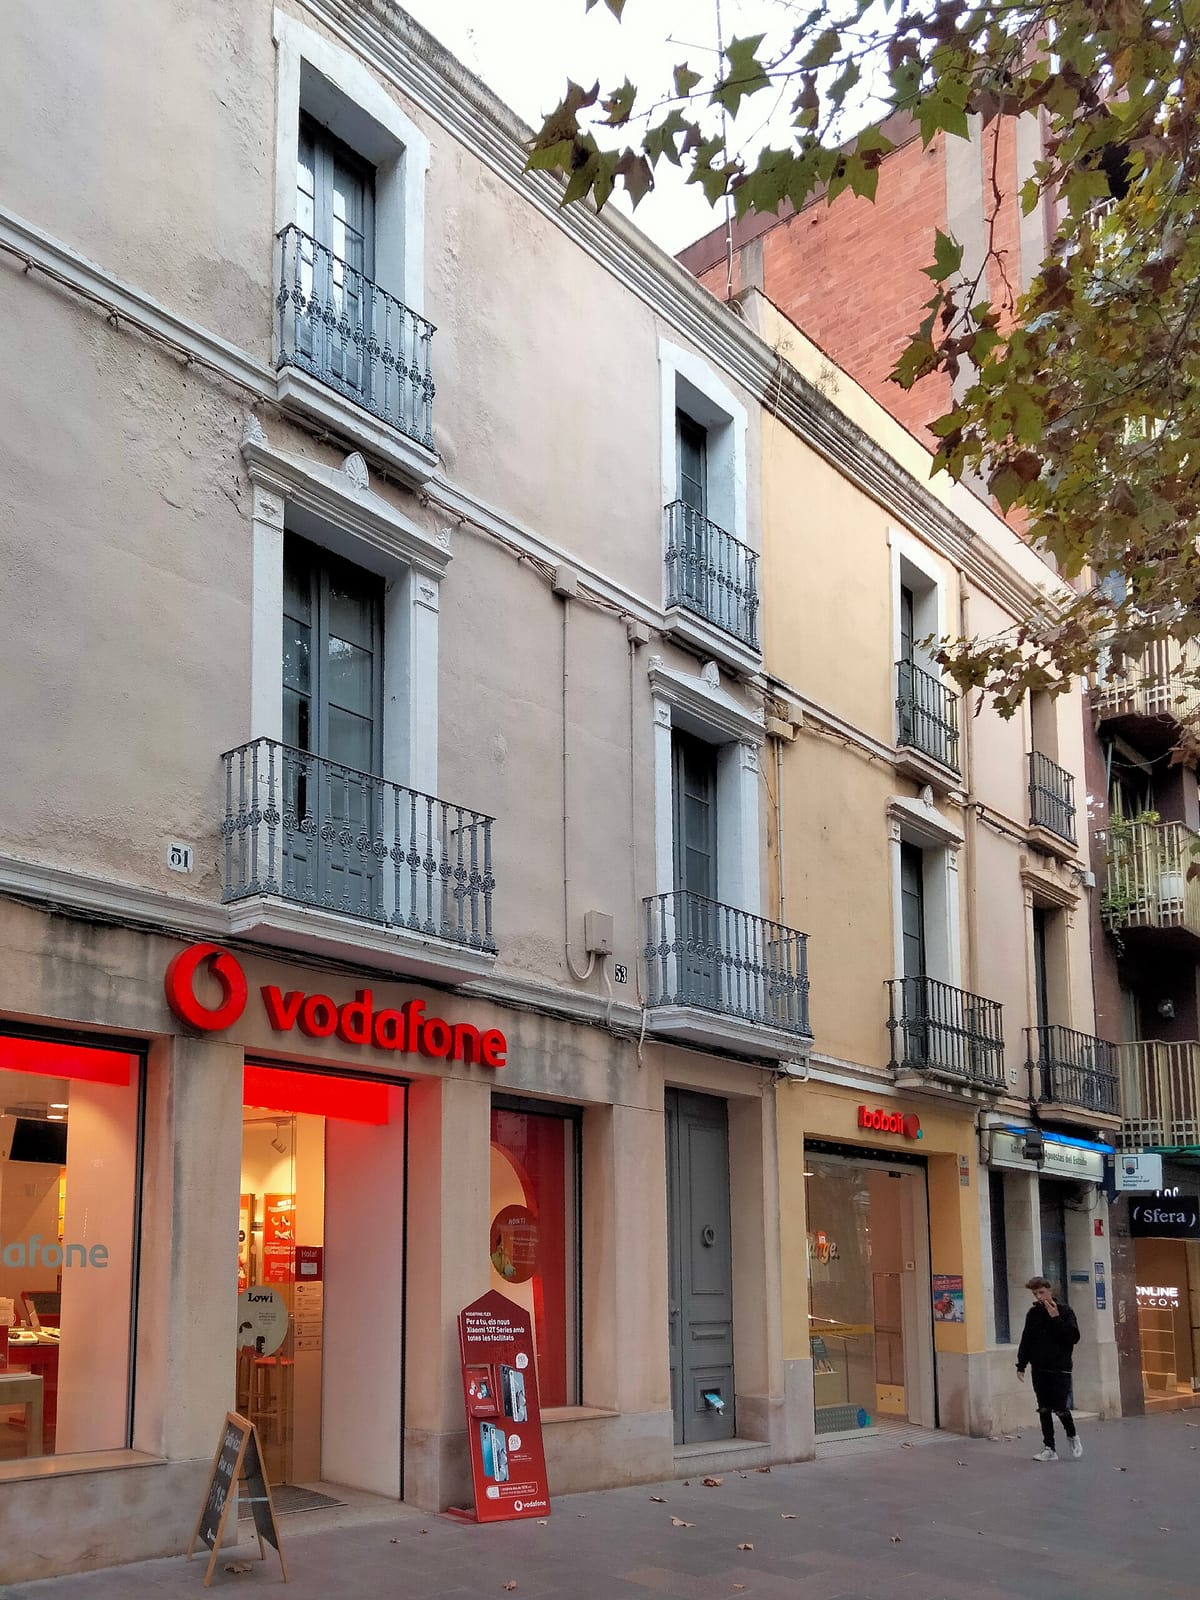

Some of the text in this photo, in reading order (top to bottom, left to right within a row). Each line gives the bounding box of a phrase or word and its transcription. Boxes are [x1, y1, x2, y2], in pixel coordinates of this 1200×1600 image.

[171, 847, 189, 868] 51
[615, 966, 627, 983] 53
[260, 985, 508, 1068] vodafone
[0, 1234, 109, 1268] afone
[247, 1292, 273, 1303] Lowi
[523, 1500, 546, 1508] vodafone
